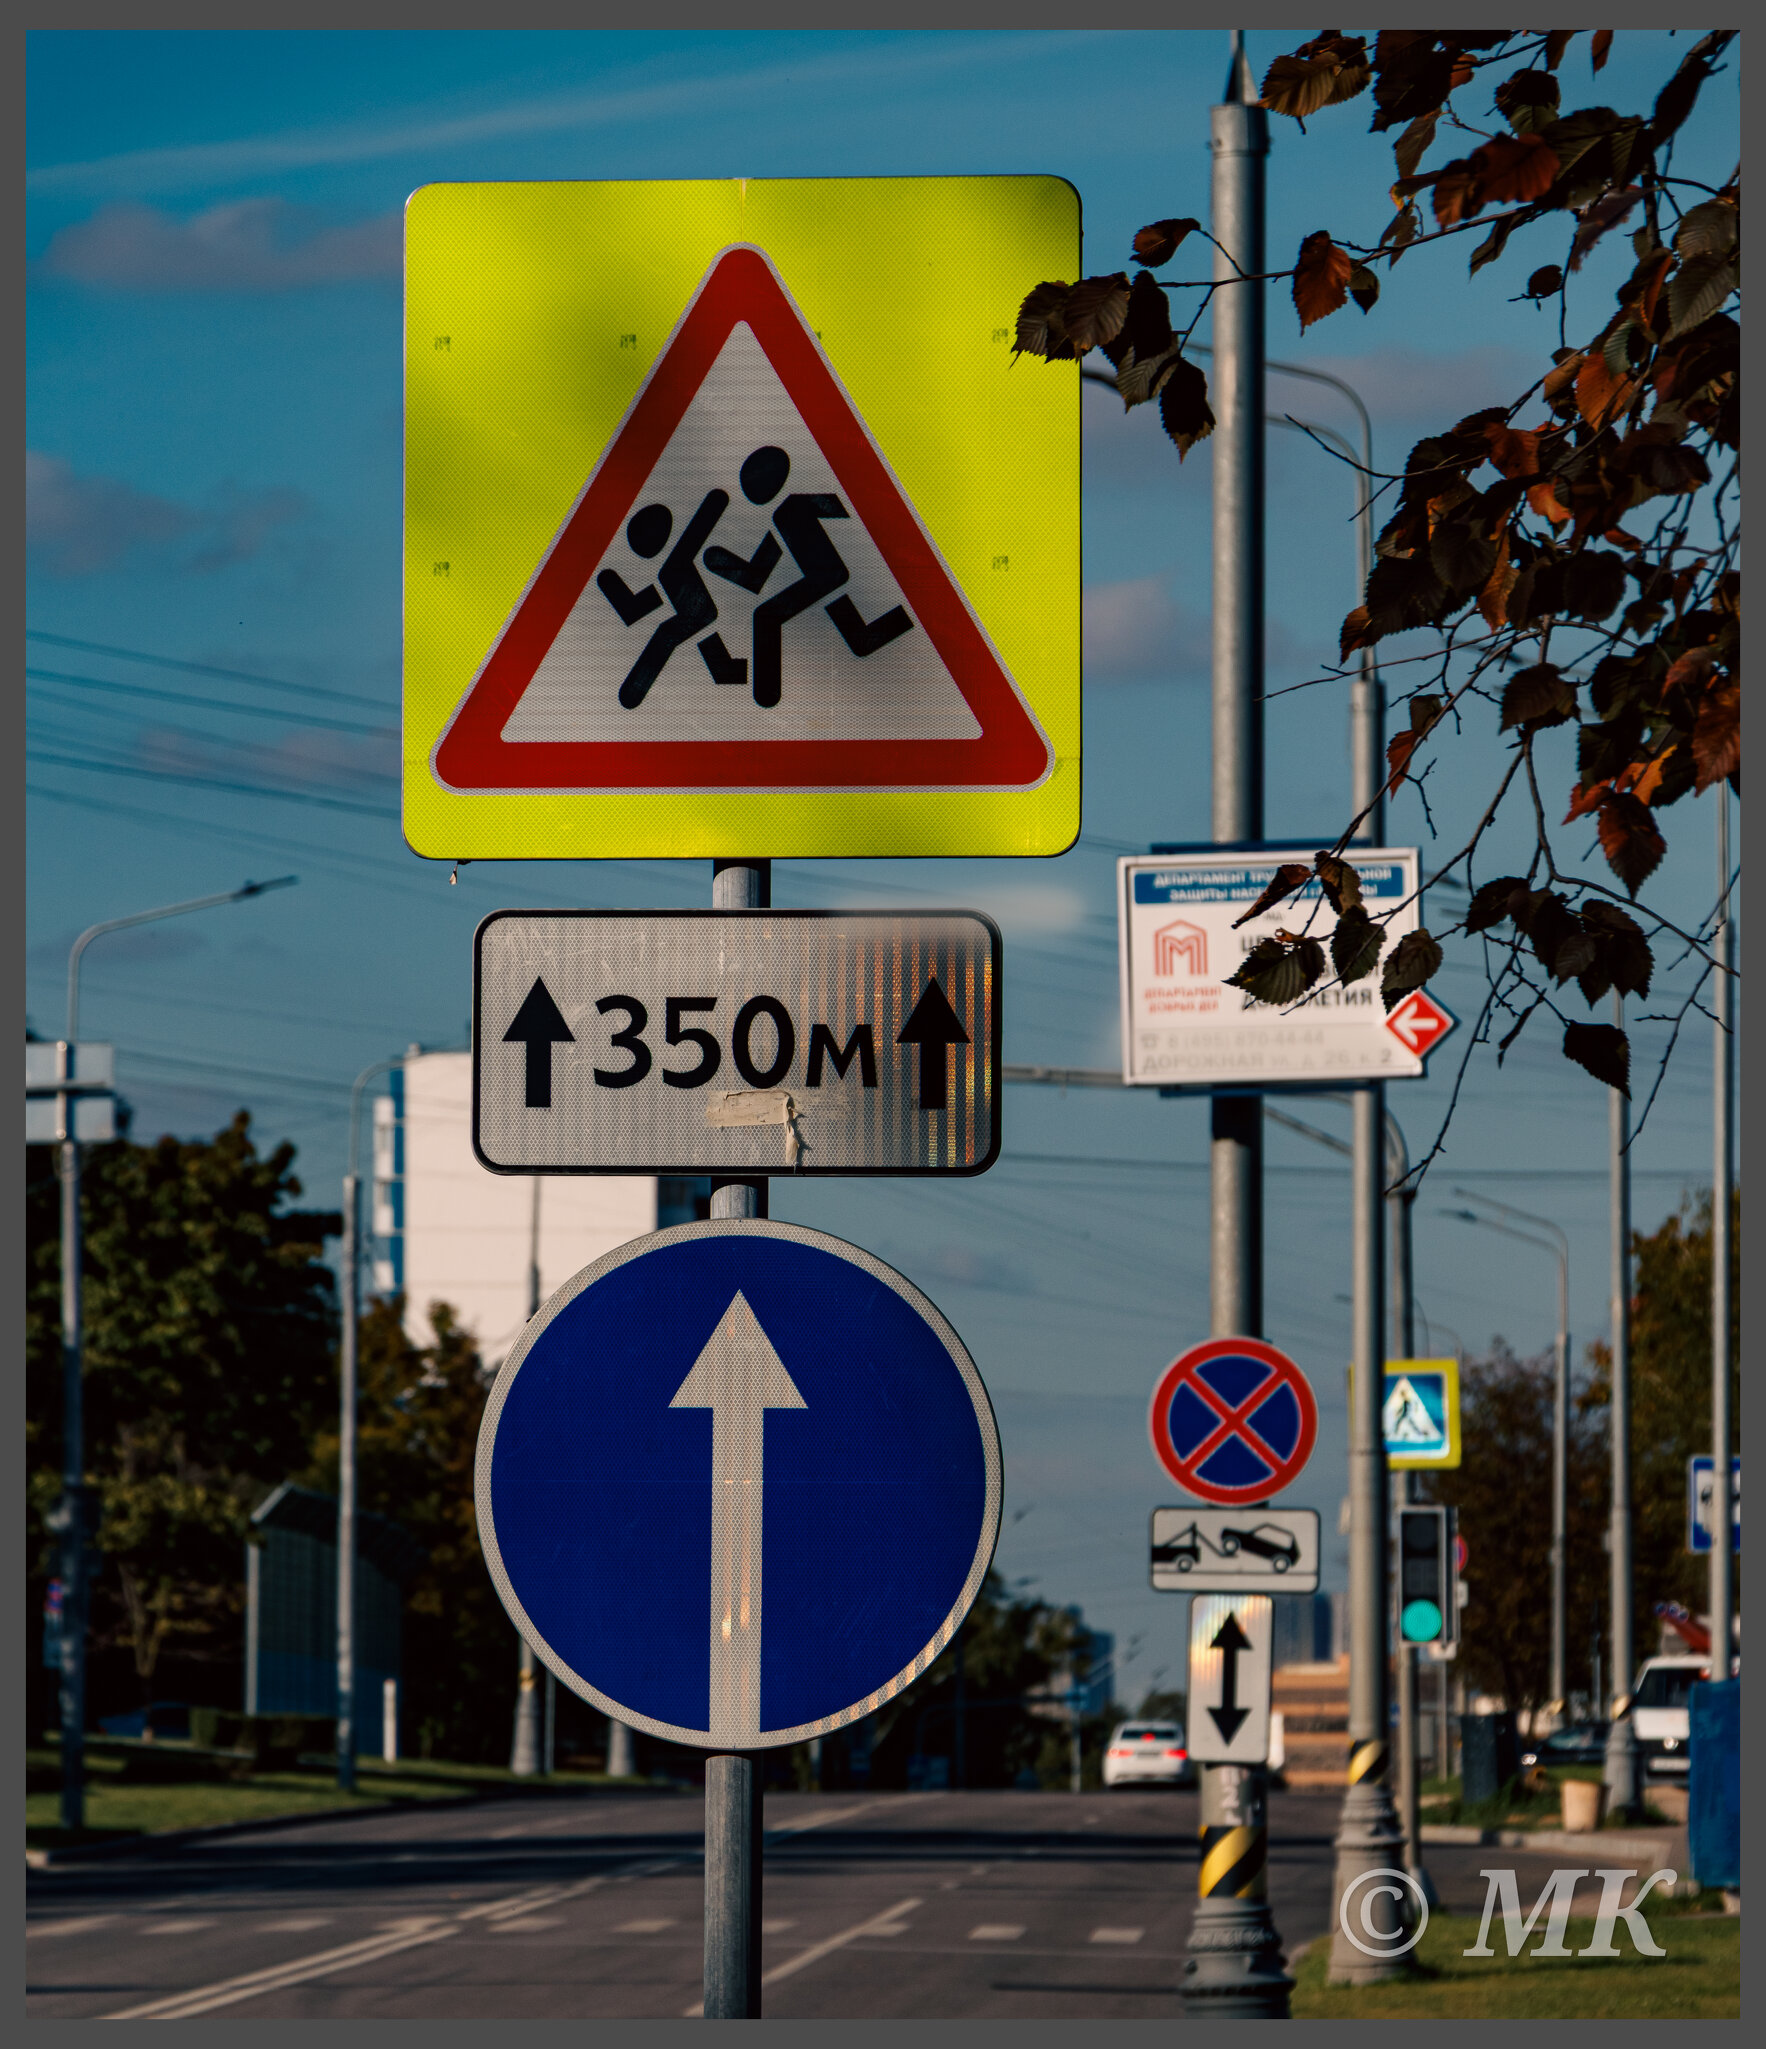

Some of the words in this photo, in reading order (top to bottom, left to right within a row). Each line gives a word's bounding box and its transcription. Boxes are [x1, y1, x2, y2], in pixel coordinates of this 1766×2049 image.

[1153, 870, 1245, 887] ДЕПАРТАМЕНТ
[1169, 887, 1227, 901] ЗАЩИТЫ
[1142, 1052, 1264, 1073] ДОРОЖНАЯ
[1380, 1047, 1392, 1064] 2
